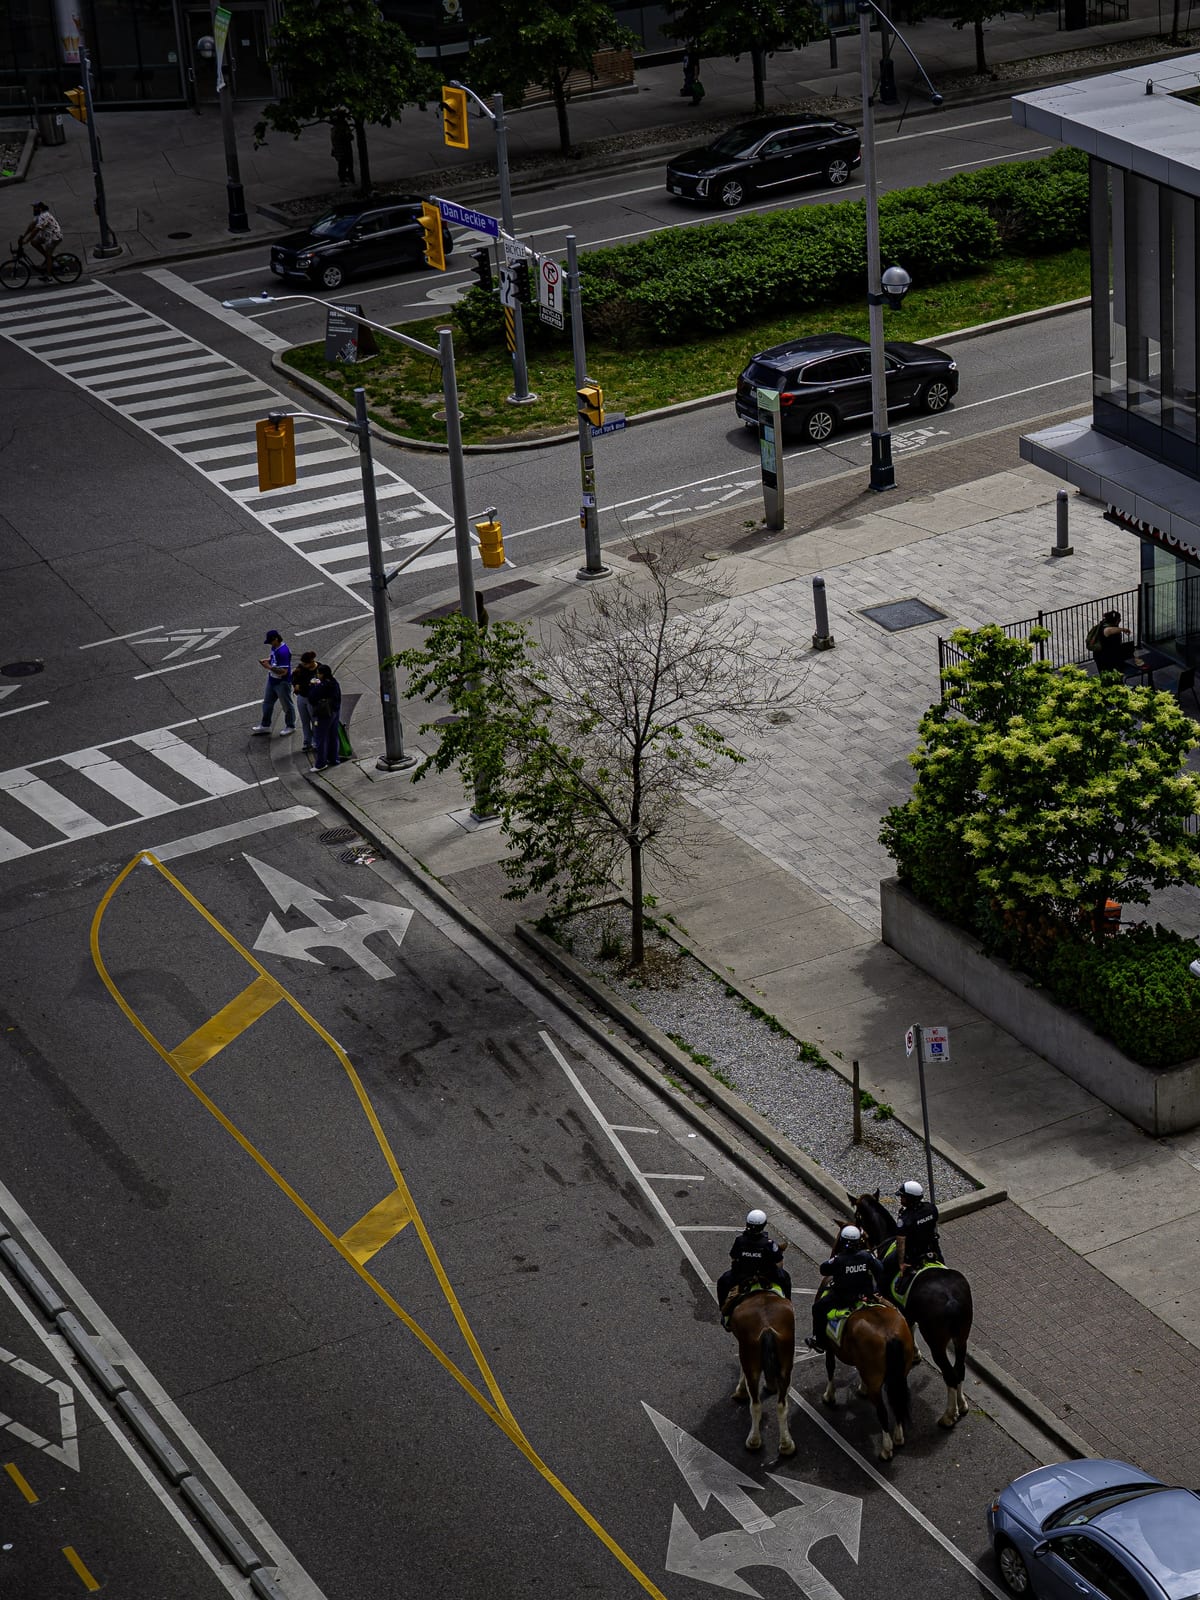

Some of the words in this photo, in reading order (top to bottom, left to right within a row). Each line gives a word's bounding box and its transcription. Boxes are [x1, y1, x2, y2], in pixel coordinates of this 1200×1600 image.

[442, 203, 459, 220] Dan
[460, 208, 487, 229] Leckie
[504, 242, 526, 257] BICYCLE
[916, 1214, 935, 1226] POLICE
[742, 1251, 763, 1259] POLICE
[845, 1263, 867, 1275] POLICE
